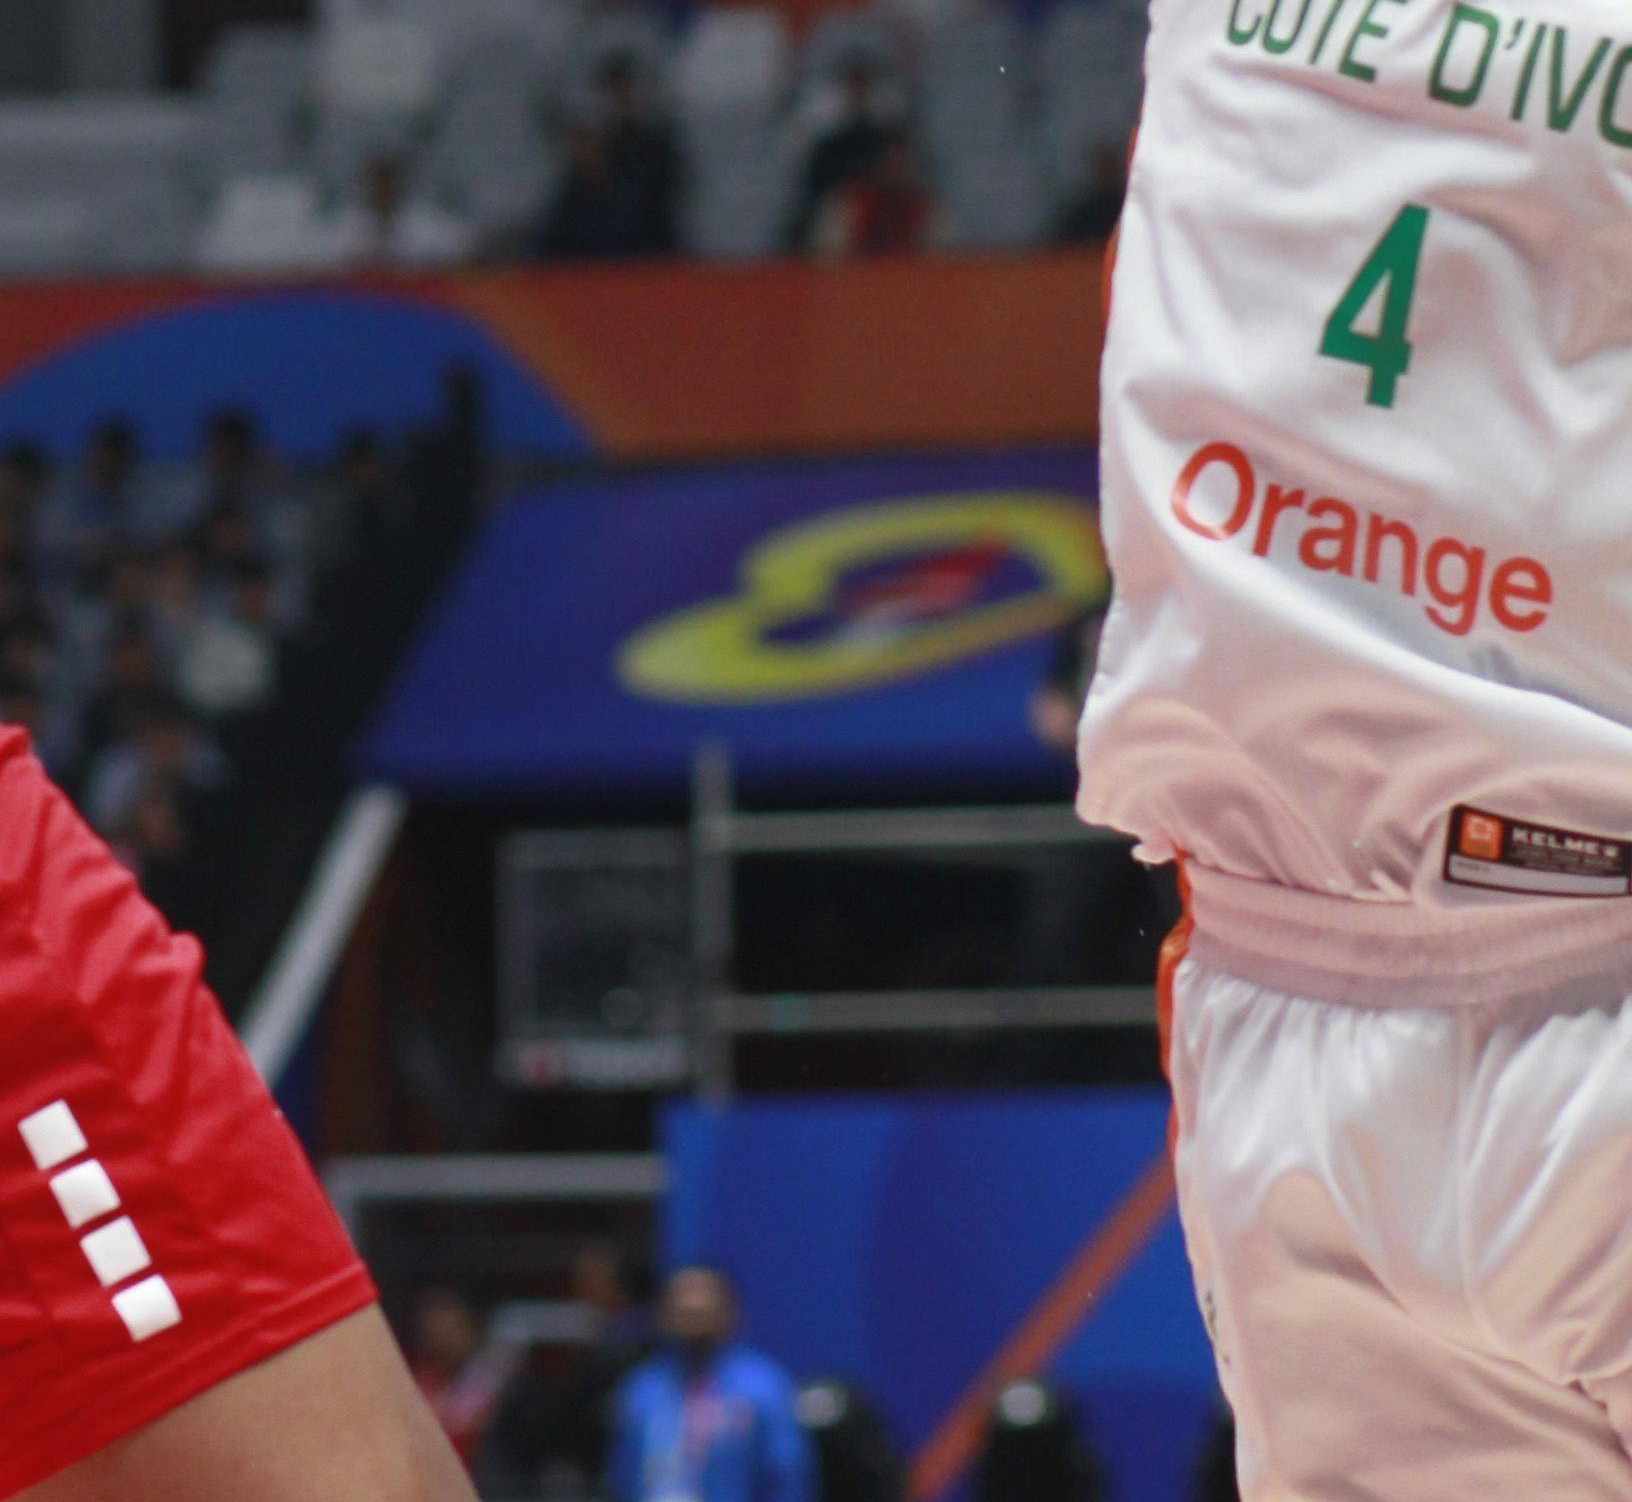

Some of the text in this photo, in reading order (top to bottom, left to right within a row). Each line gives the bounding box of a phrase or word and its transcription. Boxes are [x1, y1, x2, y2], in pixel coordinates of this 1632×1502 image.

[1318, 202, 1431, 409] 4
[1171, 441, 1553, 637] Orange
[1511, 825, 1600, 856] KELME
